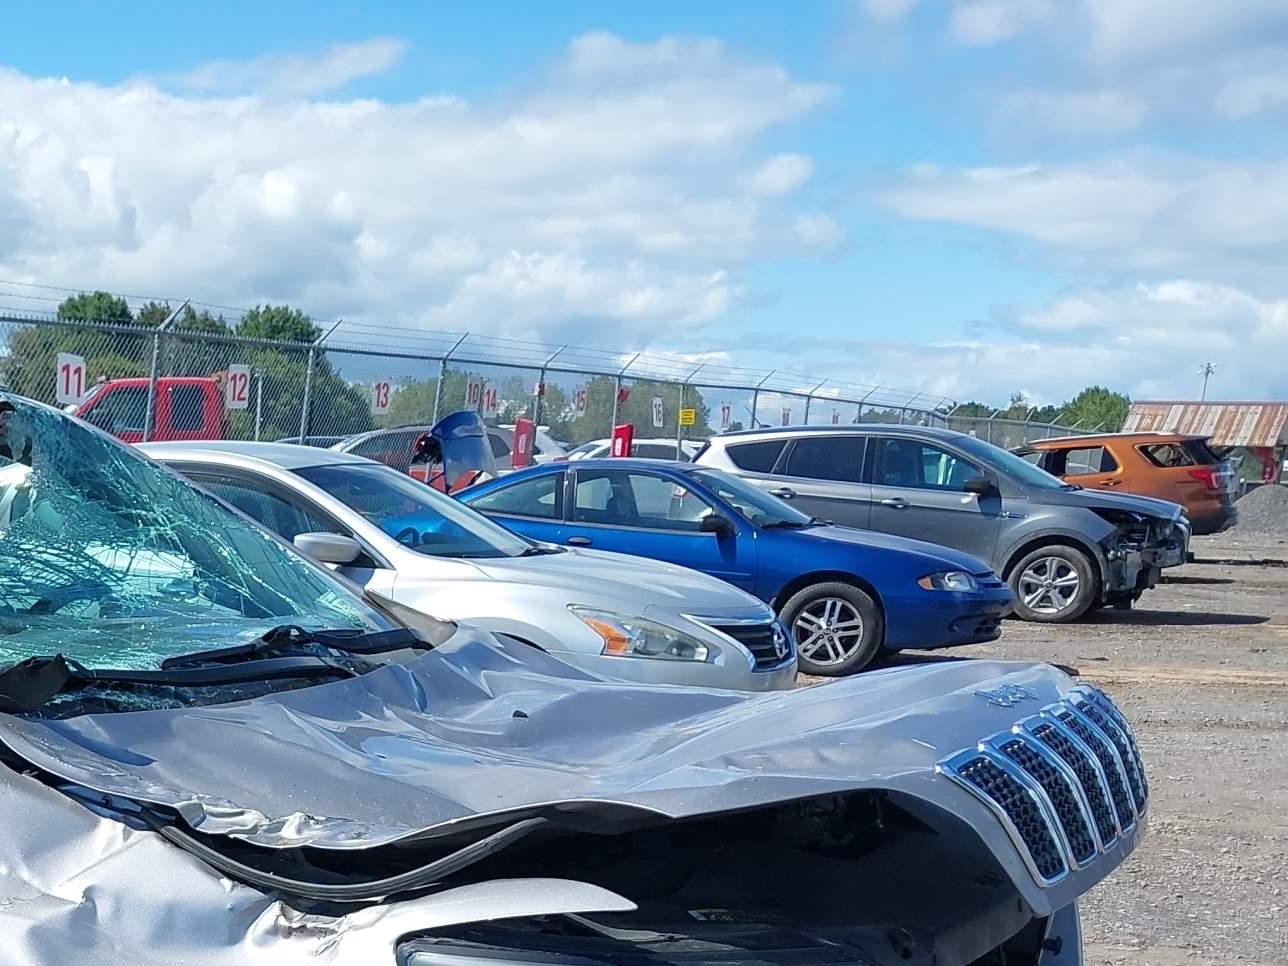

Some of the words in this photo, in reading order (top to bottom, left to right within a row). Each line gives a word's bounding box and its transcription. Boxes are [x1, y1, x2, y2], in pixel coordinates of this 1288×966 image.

[62, 364, 83, 398] 11
[230, 373, 248, 402] 12
[375, 382, 389, 408] 13
[486, 389, 497, 411] 14
[576, 390, 586, 411] 15
